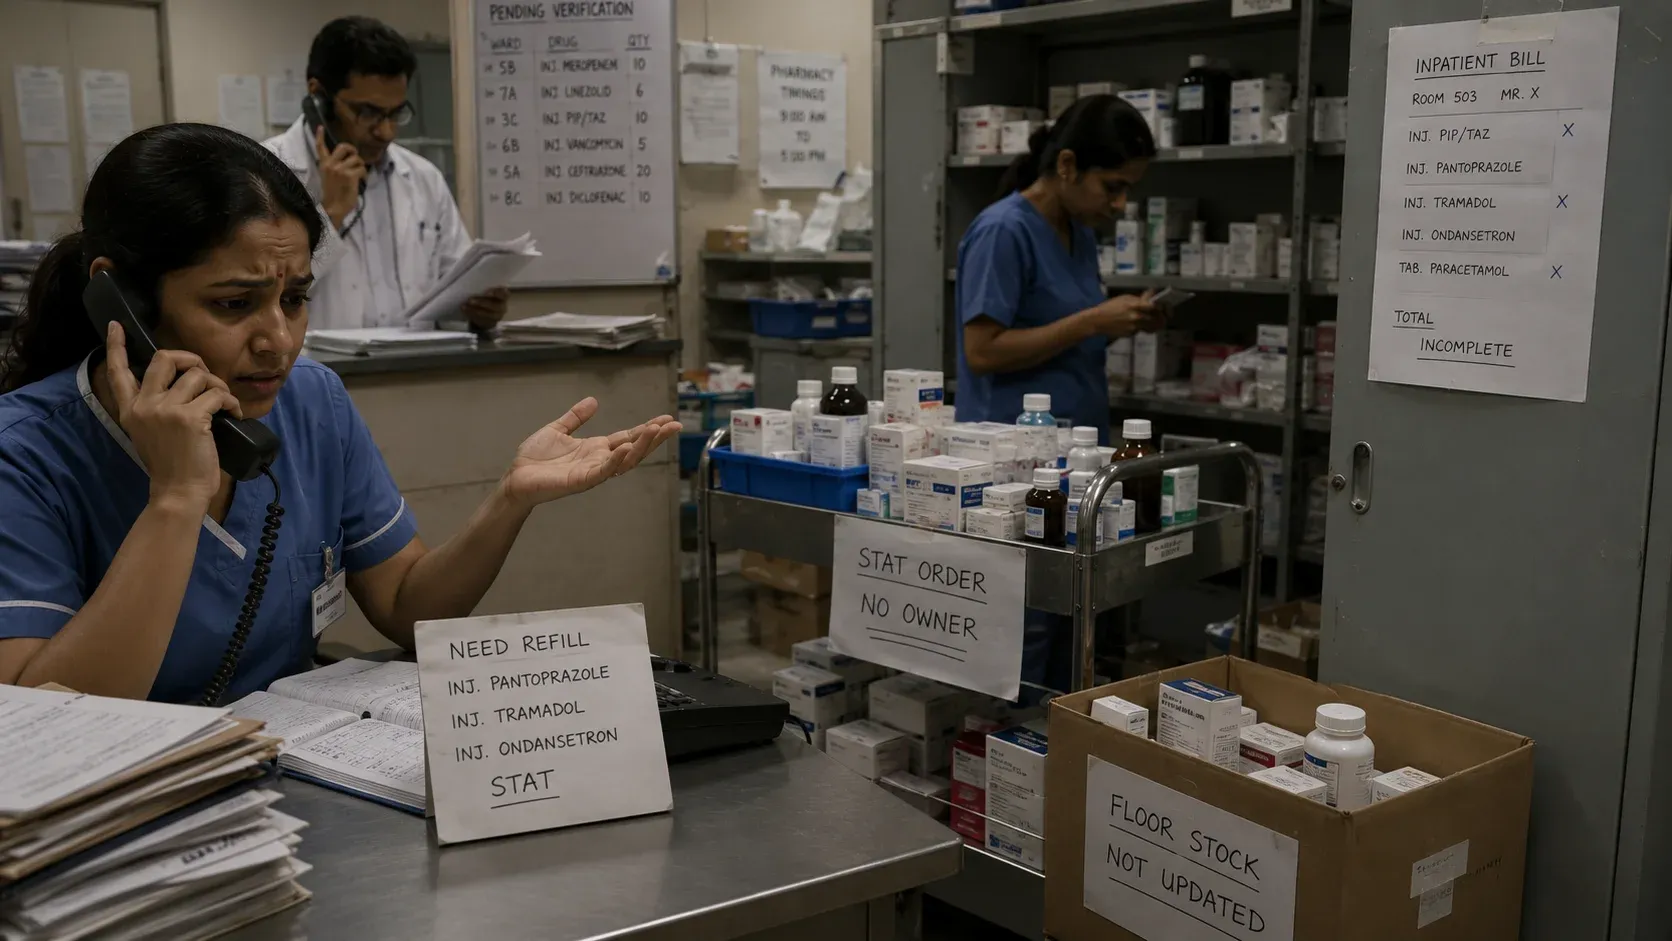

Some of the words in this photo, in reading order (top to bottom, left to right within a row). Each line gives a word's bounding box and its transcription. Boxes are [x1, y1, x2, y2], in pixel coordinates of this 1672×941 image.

[490, 4, 545, 20] PENDING
[553, 1, 634, 17] VERIFICATION
[490, 37, 521, 50] WARD
[547, 36, 579, 48] DRUG
[627, 34, 649, 47] QTY
[499, 61, 517, 75] 5B
[562, 58, 619, 72] MEROPENEM
[633, 57, 646, 70] 10
[1415, 52, 1499, 75] INPATIENT
[1509, 50, 1546, 68] BILL
[770, 64, 835, 82] PHARMACY
[499, 87, 518, 100] 7A
[564, 85, 612, 98] LINEZOLID
[635, 83, 644, 97] 6
[1412, 92, 1445, 106] ROOM
[1454, 91, 1477, 103] 503
[1500, 88, 1524, 100] MR.
[1530, 87, 1540, 99] X
[501, 113, 519, 126] 3C
[566, 110, 607, 128] PIP/TAZ
[636, 111, 649, 124] 10
[808, 111, 827, 123] AM
[796, 130, 811, 143] TO
[1408, 130, 1431, 143] INJ.
[1439, 126, 1491, 144] PIP/TAZ
[502, 139, 520, 152] 6B
[566, 138, 624, 151] VANCOMYCIN
[638, 137, 647, 151] 5
[808, 150, 826, 162] PM
[503, 165, 521, 179] 5A
[636, 165, 651, 177] 20
[1406, 163, 1429, 175] INJ.
[1436, 160, 1523, 174] PANTOPRAZOLE
[504, 192, 522, 206] 8C
[569, 191, 626, 204] DICLOFENAC
[639, 191, 651, 204] 10
[1403, 197, 1426, 209] INJ.
[1434, 197, 1497, 209] TRAMADOL
[1402, 229, 1424, 241] INJ.
[1431, 229, 1516, 243] ONDANSETRON
[1399, 261, 1422, 275] TAB.
[1430, 263, 1509, 277] PARACETAMOL
[1394, 310, 1434, 325] TOTAL
[1420, 337, 1513, 358] INCOMPLETE
[858, 547, 908, 575] STAT
[918, 561, 987, 594] ORDER
[861, 593, 890, 617] NO
[902, 603, 978, 641] OWNER
[450, 638, 509, 660] NEED
[522, 632, 590, 653] REFILL
[448, 679, 480, 696] INJ.
[490, 665, 610, 690] PANTOPRAZOLE
[452, 712, 484, 729] INJ.
[494, 701, 585, 724] TRAMADOL
[455, 746, 489, 762] INJ.
[499, 727, 618, 757] ONDANSETRON
[490, 769, 555, 797] STAT
[1111, 793, 1174, 841] FLOOR
[1190, 830, 1260, 881] STOCK
[1106, 843, 1148, 878] NOT
[1161, 868, 1265, 933] UPDATED
